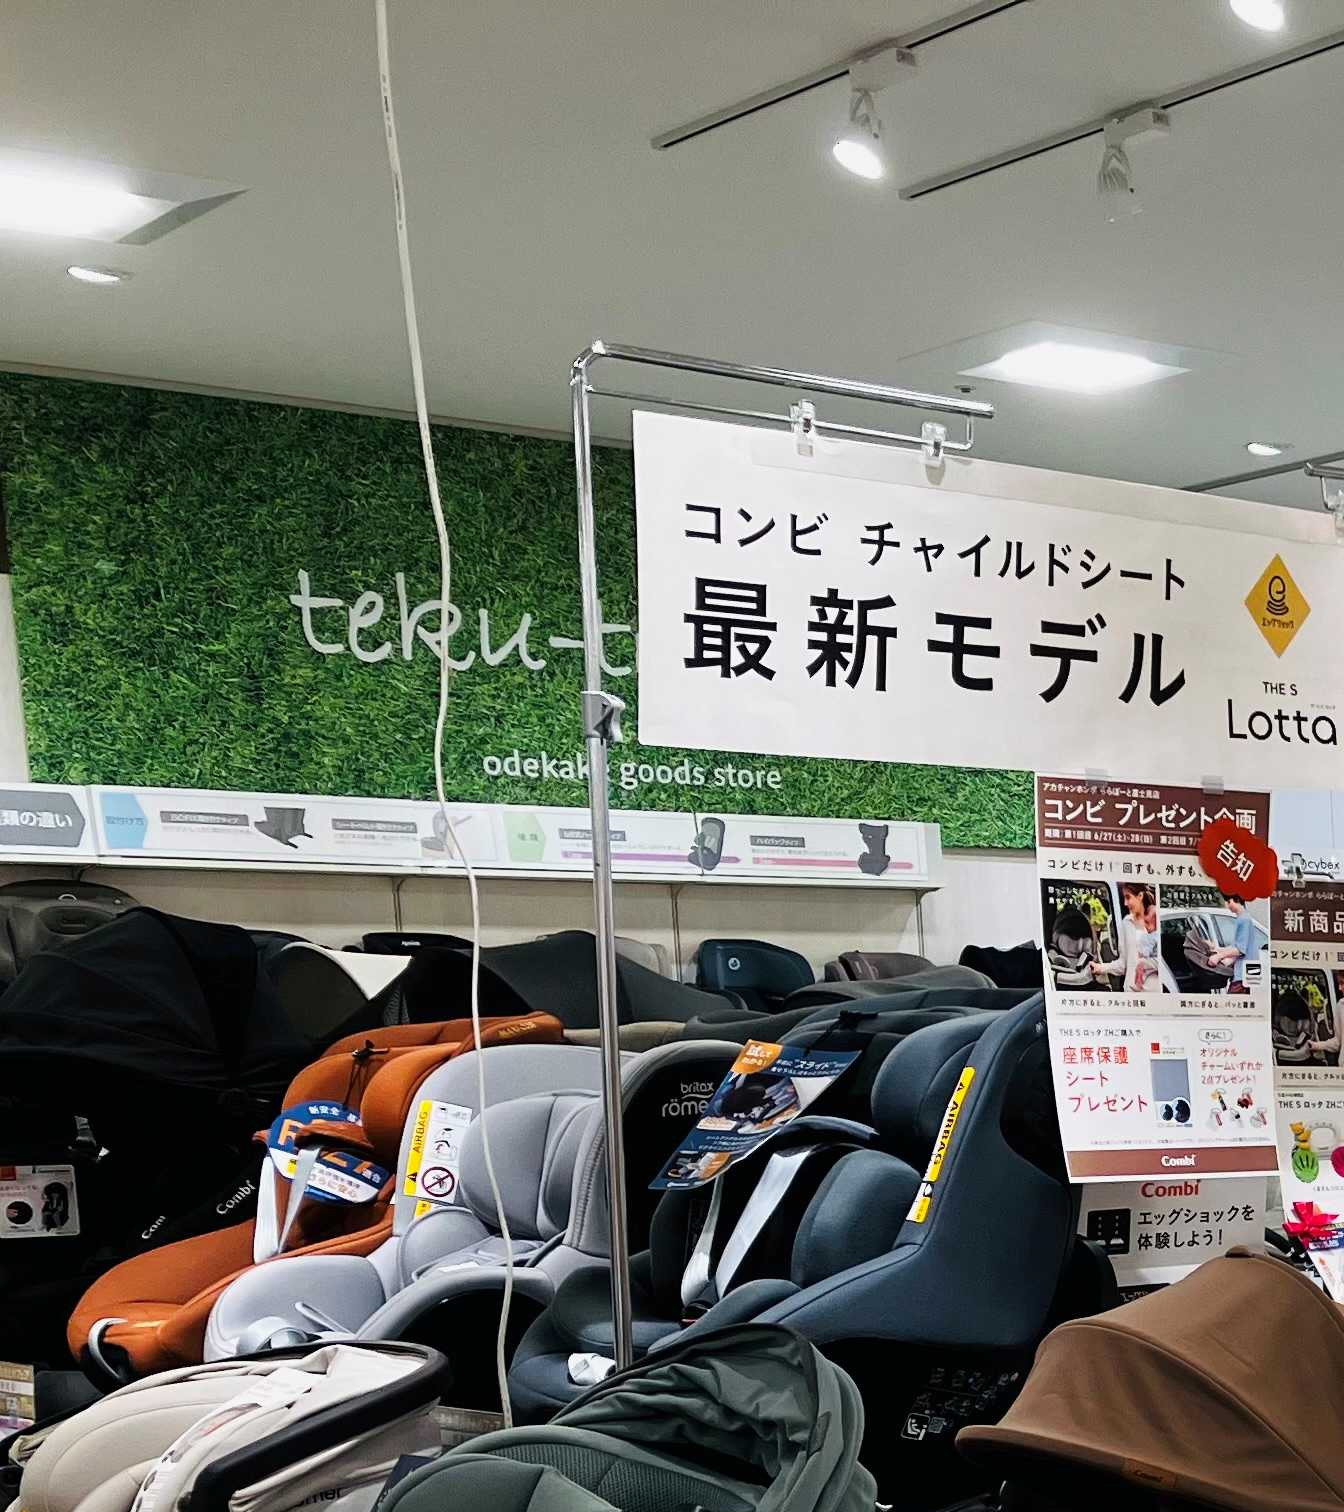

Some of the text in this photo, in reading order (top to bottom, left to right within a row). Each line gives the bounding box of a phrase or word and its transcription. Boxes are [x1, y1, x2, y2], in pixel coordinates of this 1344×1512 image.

[683, 502, 1186, 602] コンビ チャイルドシート
[683, 576, 1186, 708] 最新モデル
[1262, 681, 1297, 696] THE S
[1227, 699, 1337, 745] Lotta
[619, 758, 782, 791] goods store
[1044, 799, 1105, 822] コンビ
[1216, 839, 1254, 882] 告知
[1307, 858, 1340, 875] cybex
[1063, 1046, 1129, 1065] 座席保護
[681, 1082, 714, 1093] britax
[1066, 1071, 1109, 1087] シート
[1069, 1094, 1148, 1113] プレゼント
[411, 1111, 429, 1155] AIRBAG
[1161, 1154, 1197, 1167] Combi
[216, 1179, 256, 1215] Combi
[1141, 1179, 1201, 1198] Combi
[1138, 1205, 1255, 1226] エッグショックを
